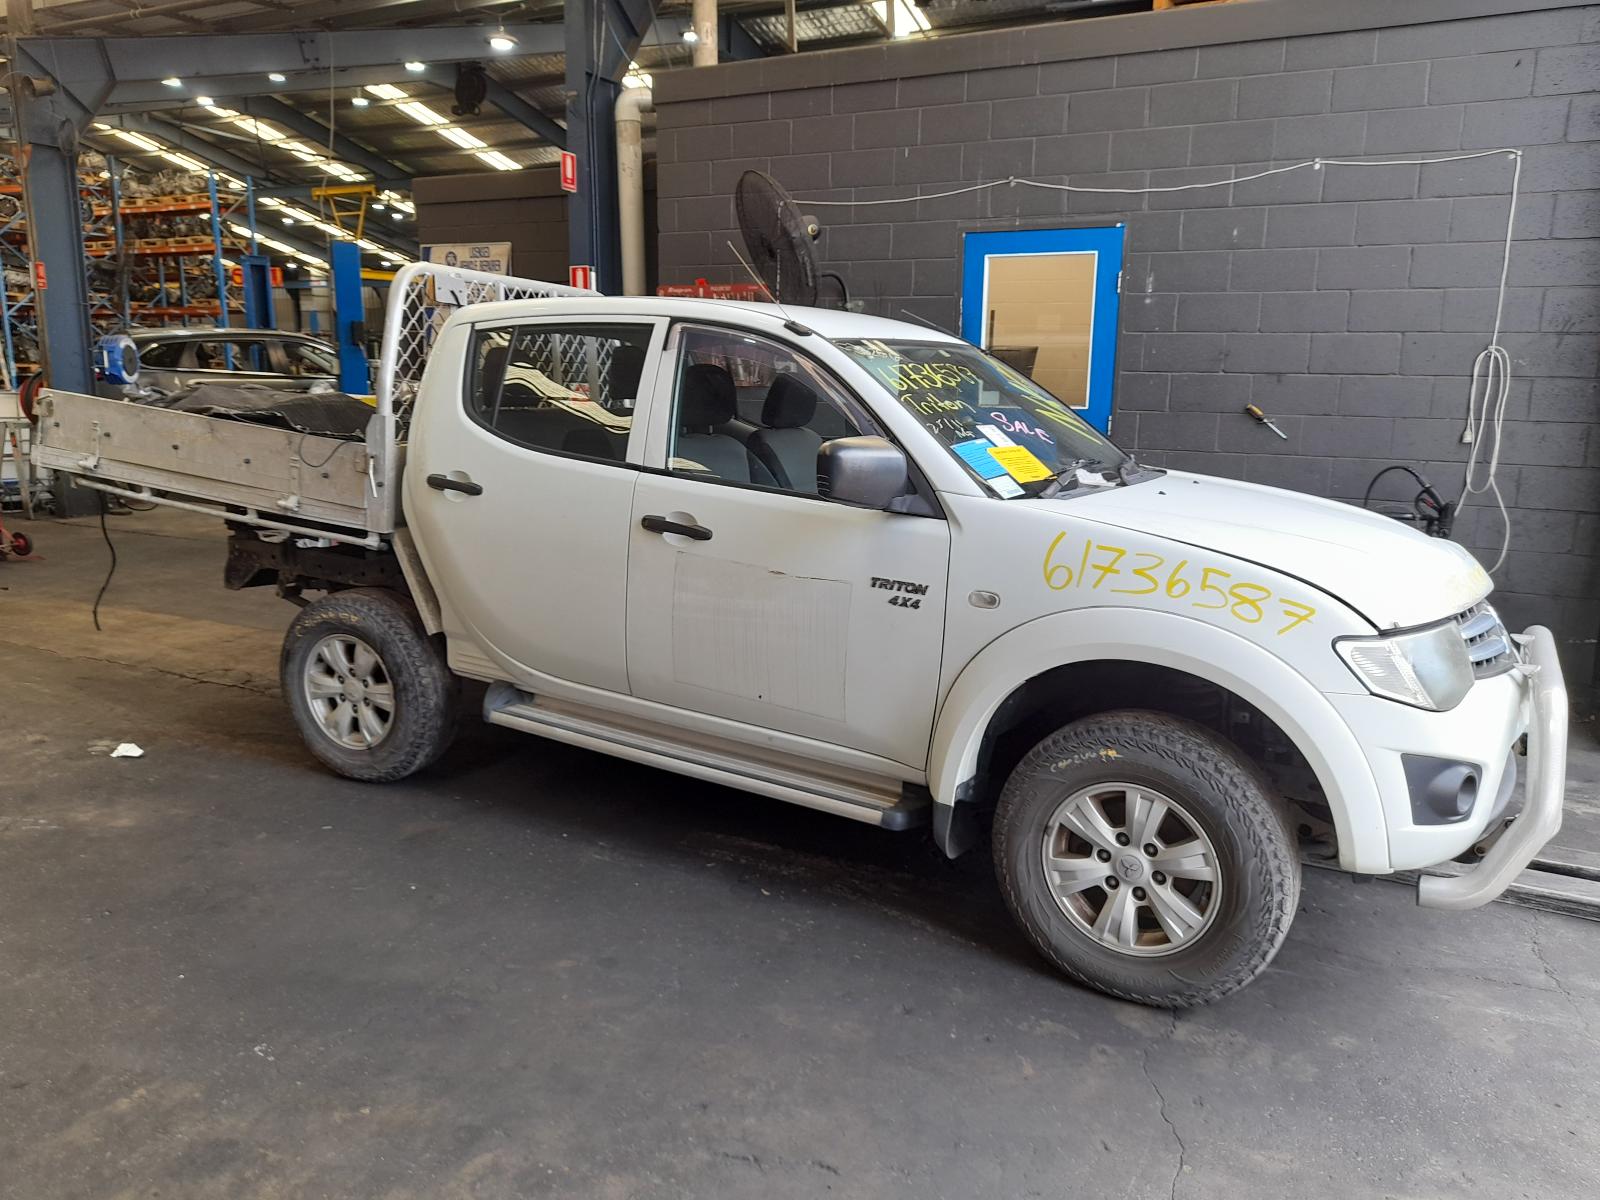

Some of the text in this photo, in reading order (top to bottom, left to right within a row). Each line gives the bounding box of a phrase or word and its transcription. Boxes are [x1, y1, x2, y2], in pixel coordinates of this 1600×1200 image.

[900, 393, 976, 415] Triton
[871, 577, 929, 595] TRITON
[1043, 531, 1316, 635] 61736587
